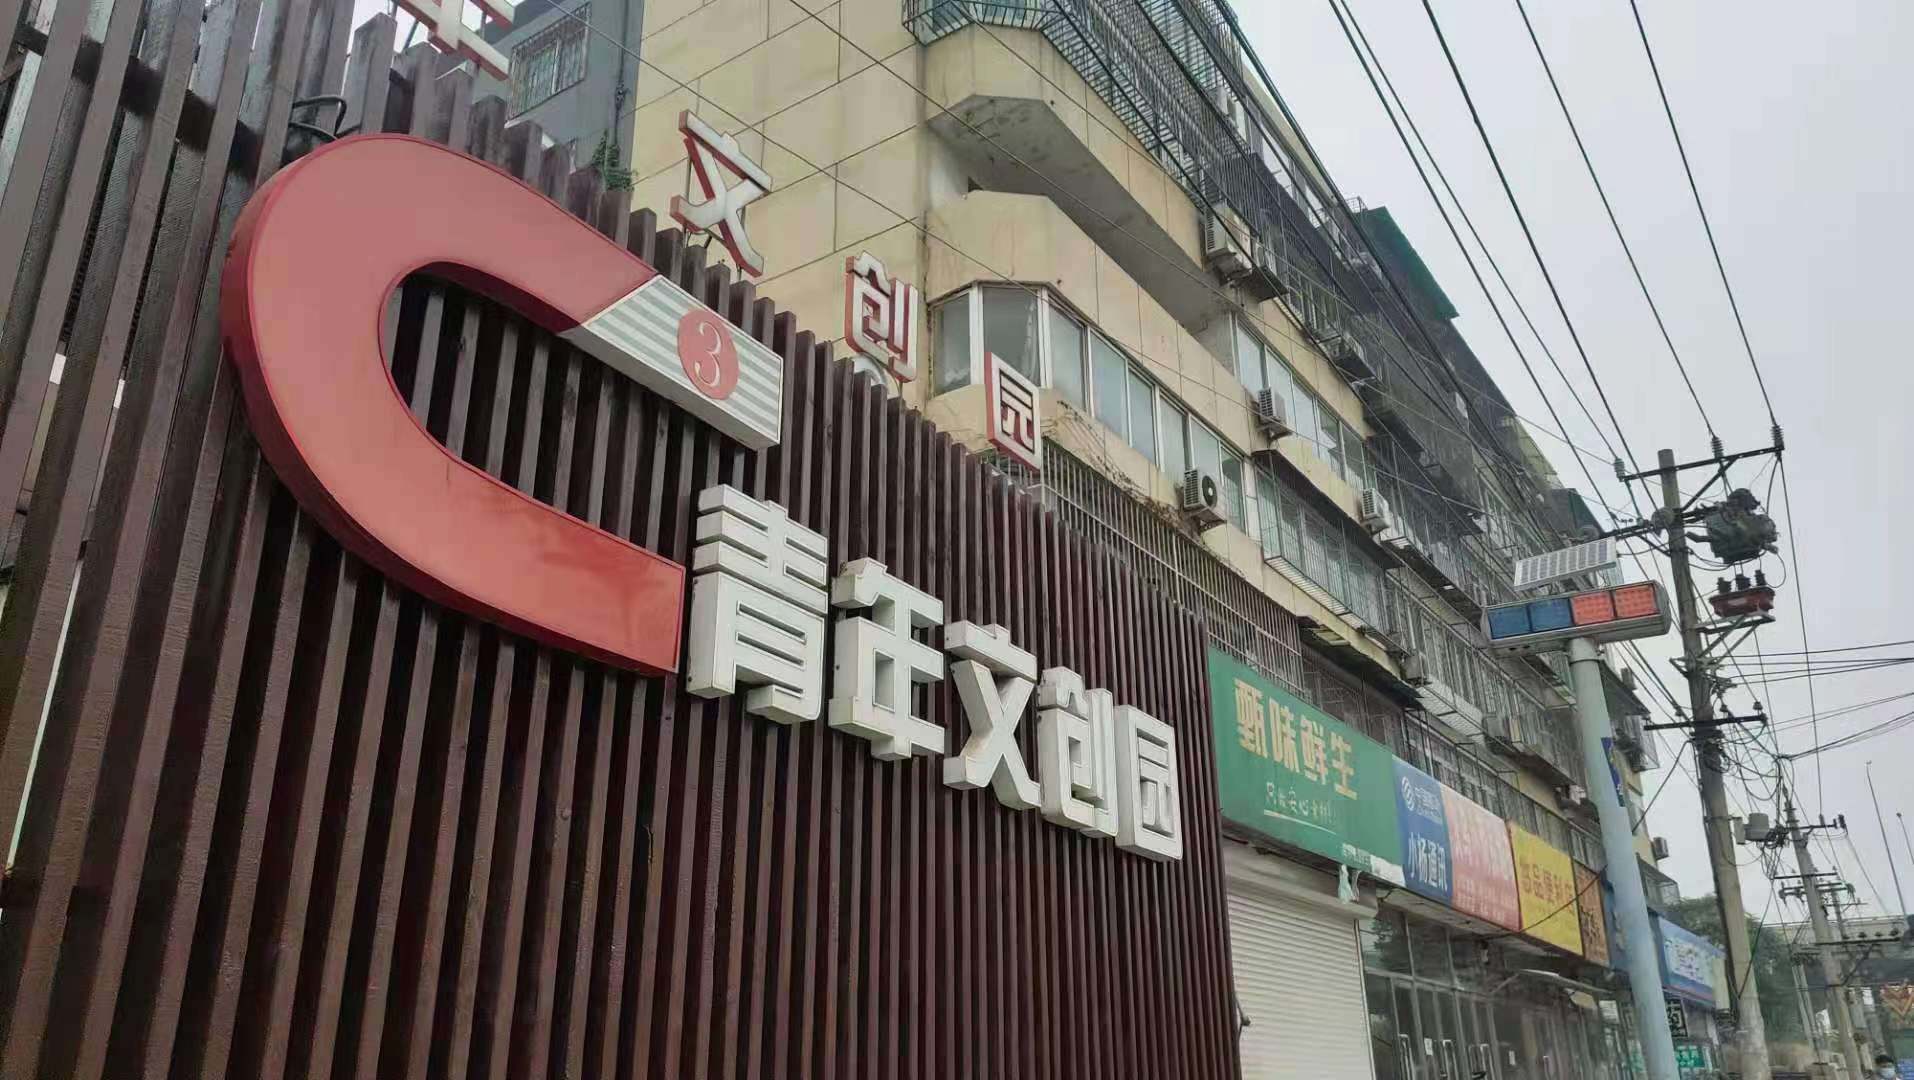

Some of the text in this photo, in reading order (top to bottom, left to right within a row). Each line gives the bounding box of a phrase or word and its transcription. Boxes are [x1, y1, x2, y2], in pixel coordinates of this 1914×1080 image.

[694, 321, 722, 388] 3
[686, 484, 1183, 861] 青年文创园
[1234, 677, 1358, 801] 甄味鲜生
[1408, 831, 1449, 893] 小杨通讯
